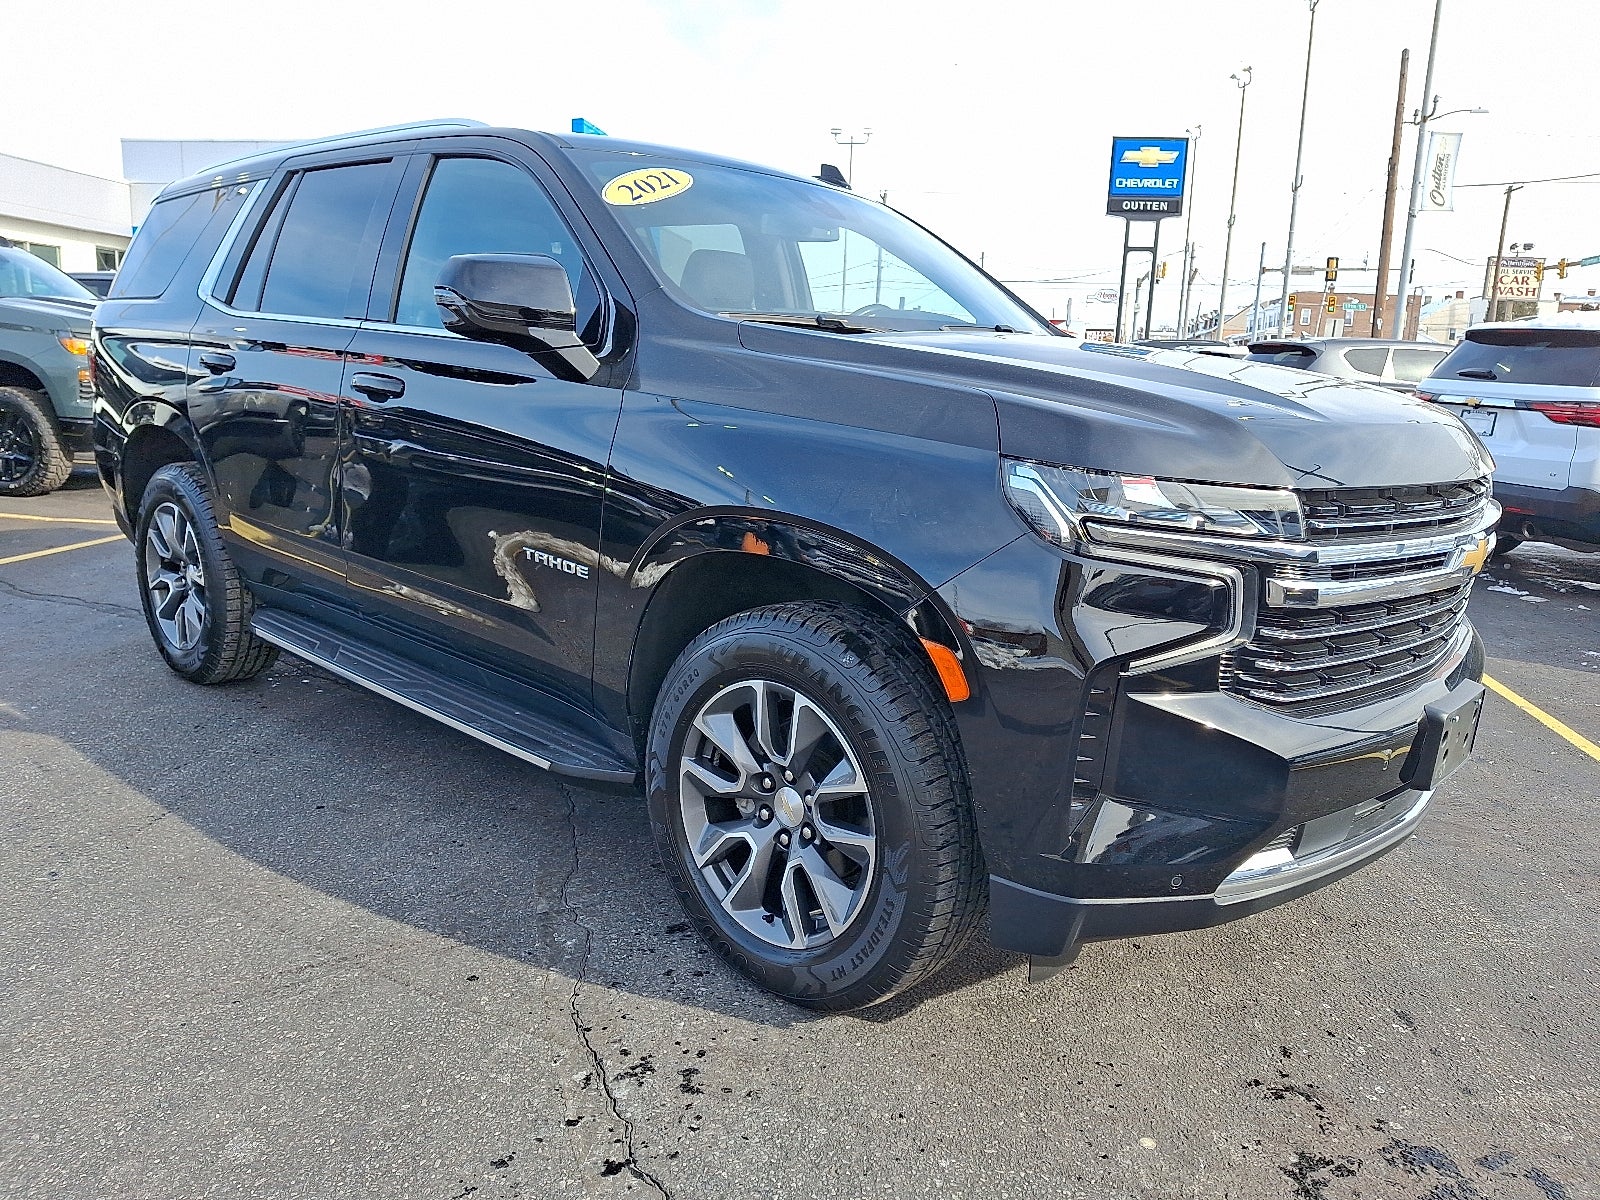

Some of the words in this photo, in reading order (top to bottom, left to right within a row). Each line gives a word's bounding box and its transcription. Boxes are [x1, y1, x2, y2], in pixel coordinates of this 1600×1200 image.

[617, 171, 680, 201] 2021
[1115, 177, 1180, 189] CHEVROLET
[1122, 200, 1168, 211] OUTTEN
[1499, 275, 1530, 286] CAR
[522, 546, 589, 580] TAHOE
[768, 641, 901, 798] WRANGLER
[851, 897, 895, 971] STEADFAST
[831, 965, 848, 982] HT
